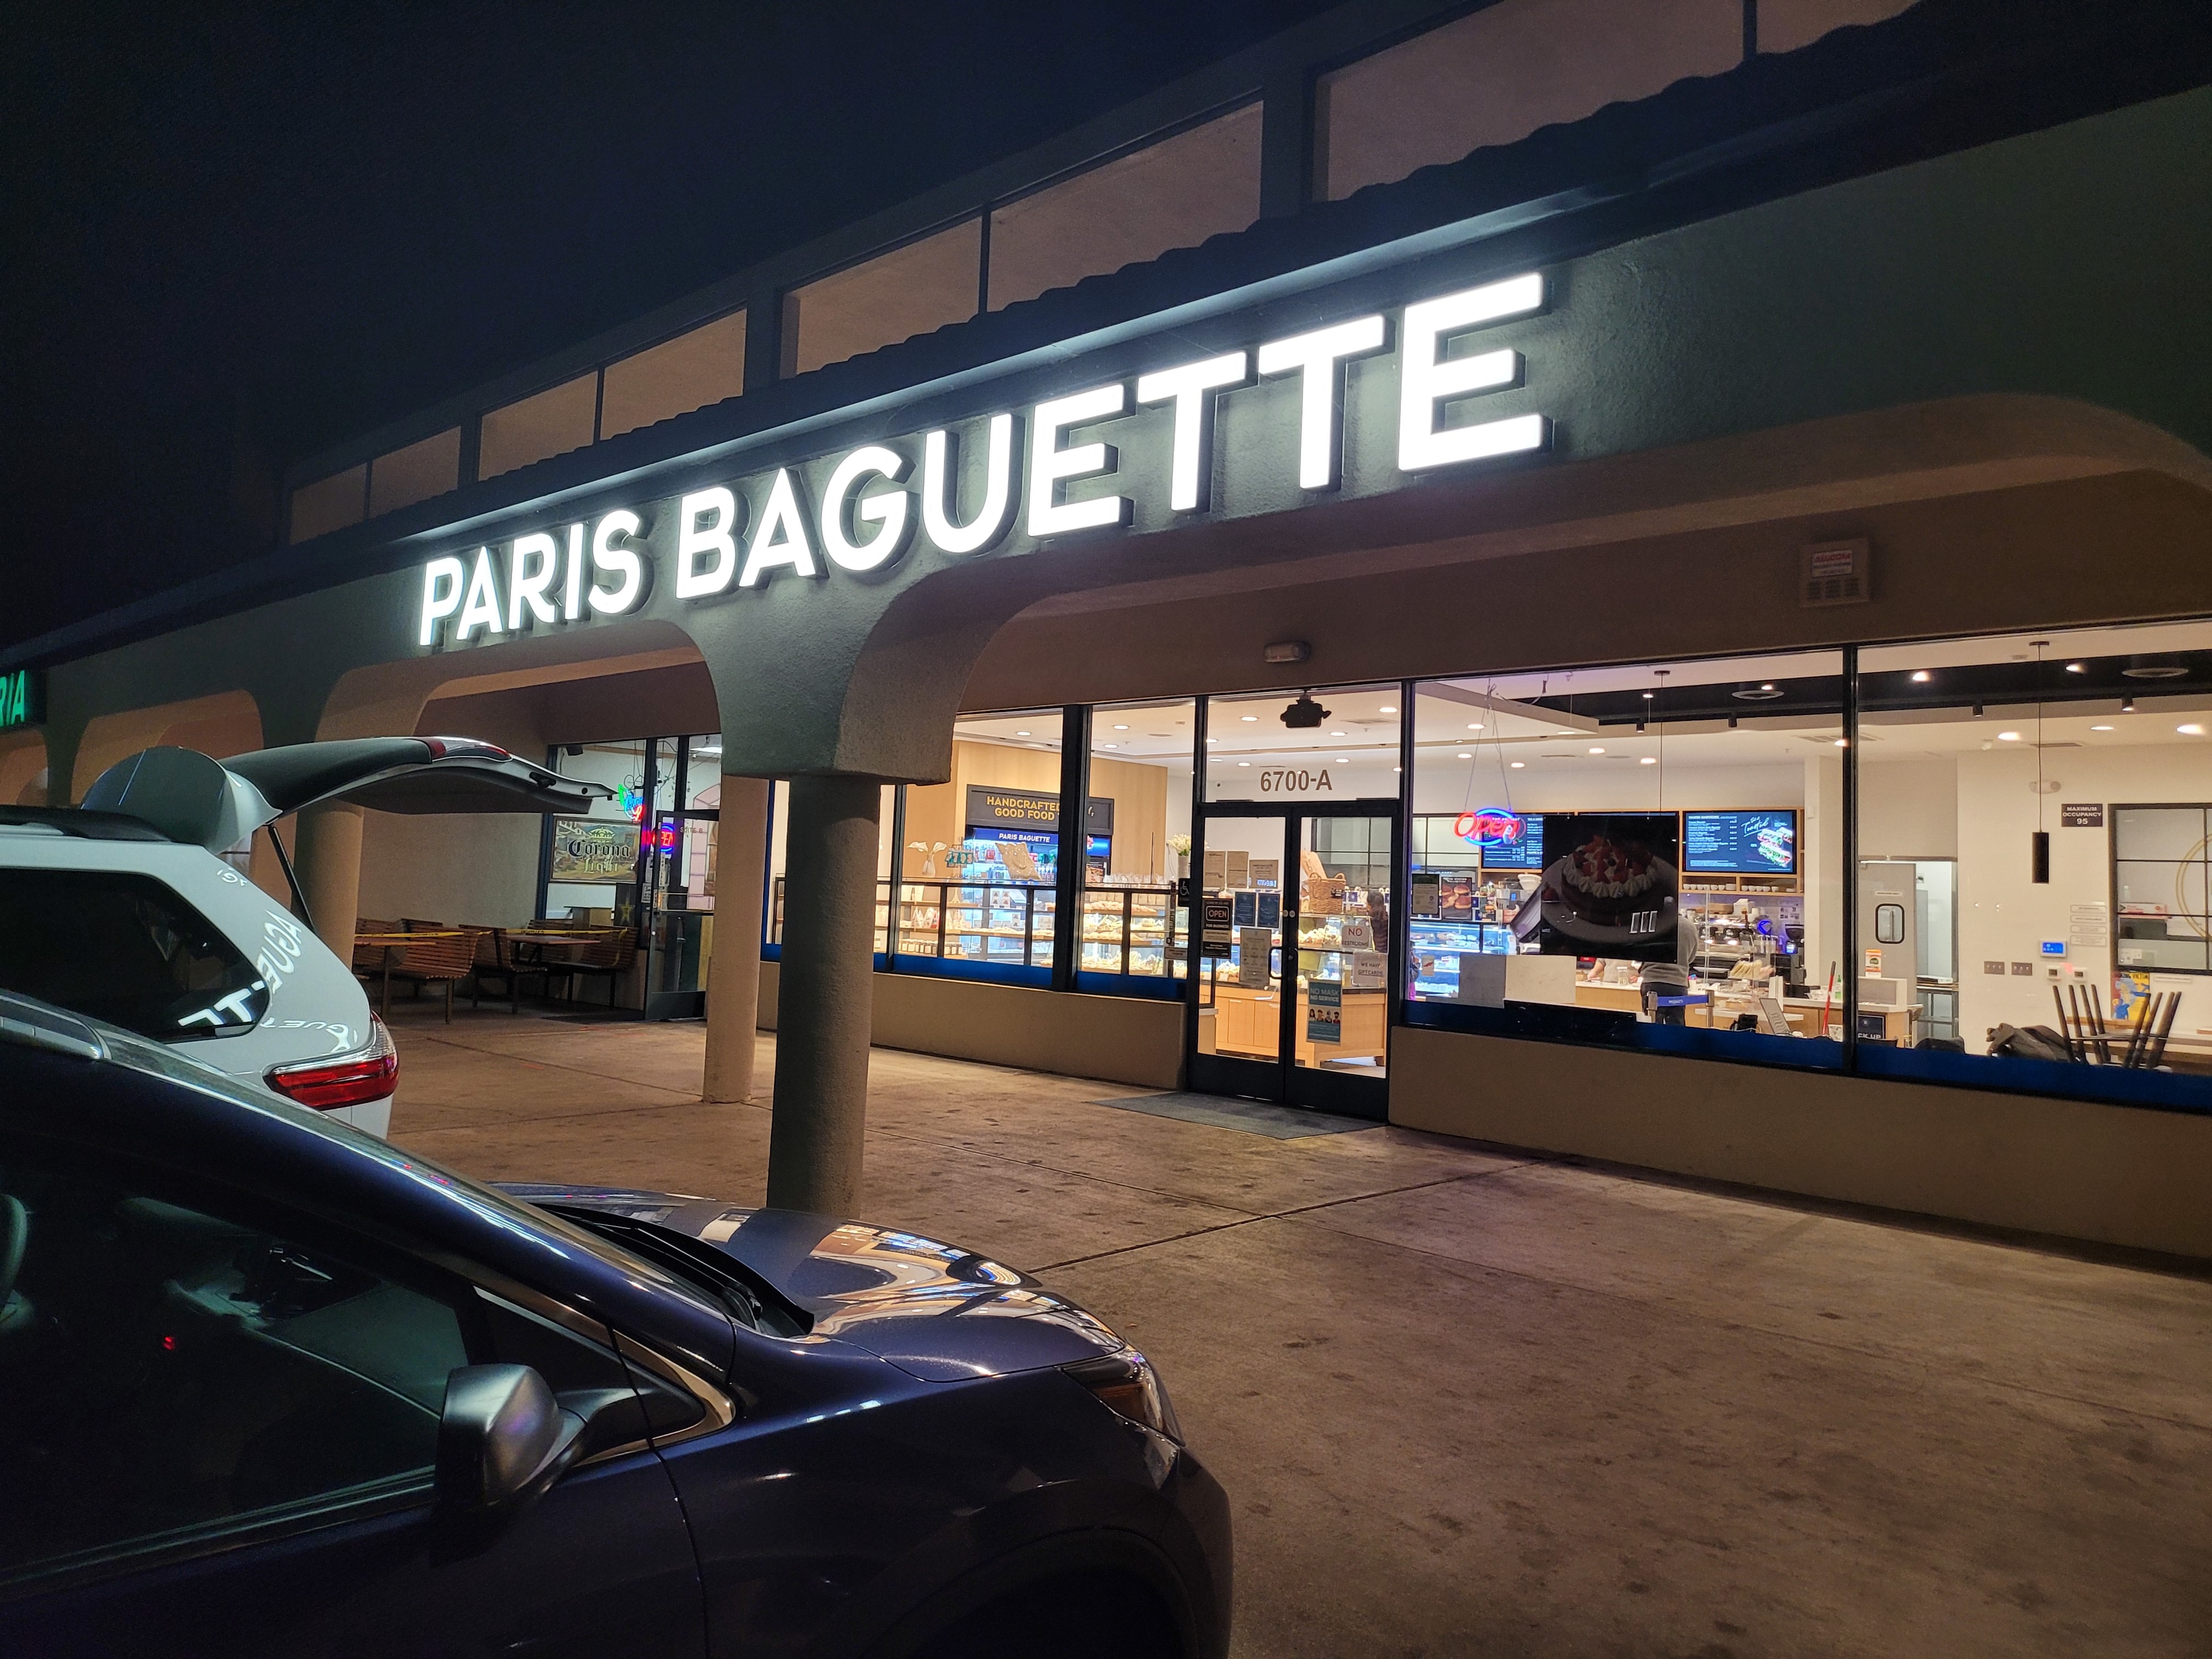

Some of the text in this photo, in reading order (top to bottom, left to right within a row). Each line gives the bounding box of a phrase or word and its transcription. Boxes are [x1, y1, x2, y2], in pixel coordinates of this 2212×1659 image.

[420, 273, 1542, 646] PARIS BAGUETTE
[1260, 769, 1333, 792] 6700-A
[995, 808, 1055, 821] GOOD FOOD
[1018, 834, 1051, 843] BAGUETTE
[567, 837, 630, 858] Corona
[1208, 910, 1227, 918] OPEN
[1348, 928, 1363, 936] NO
